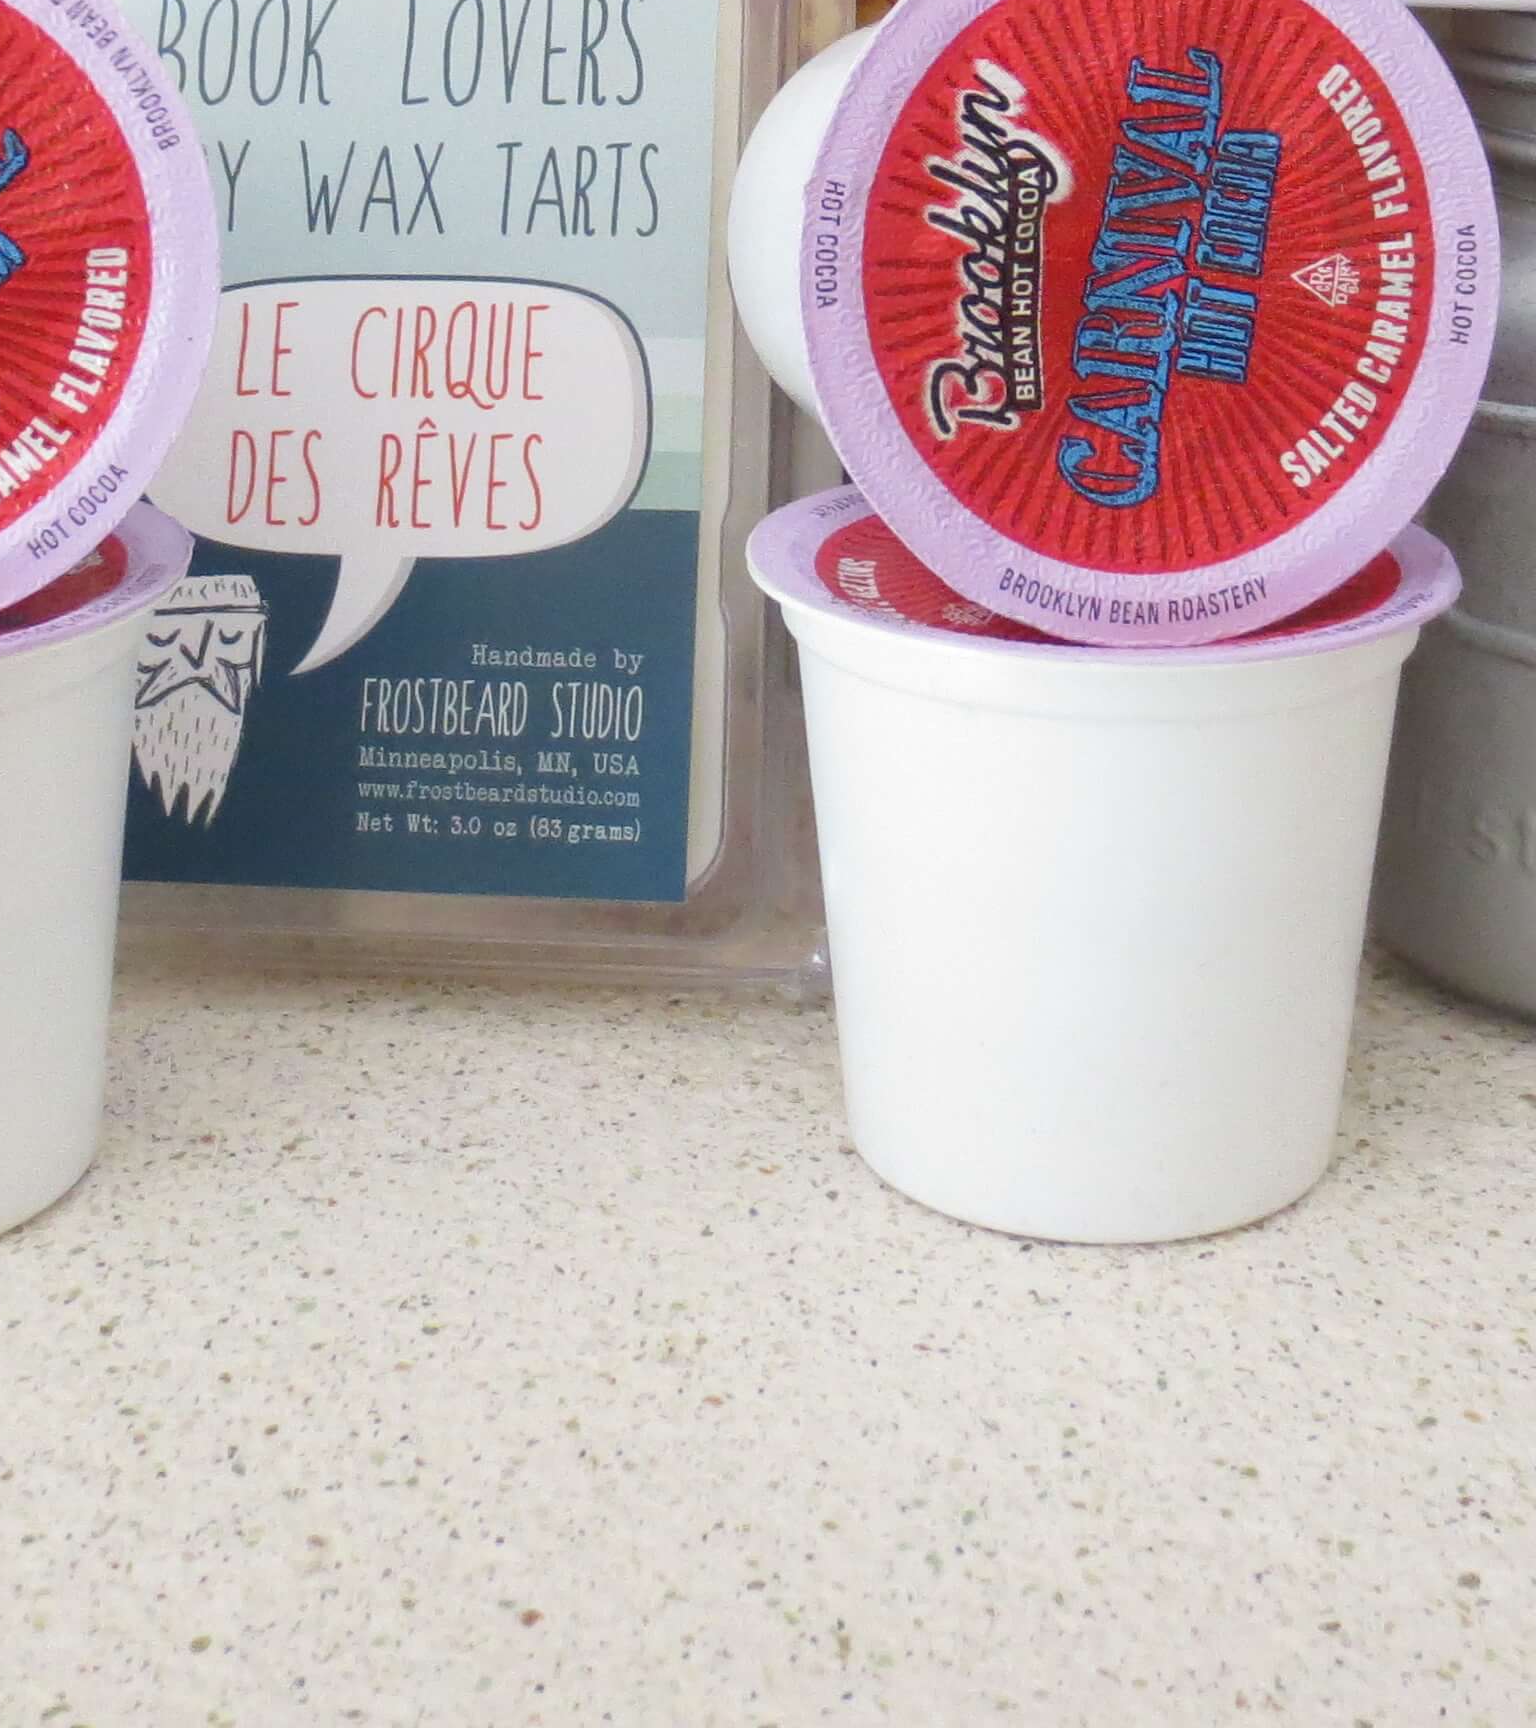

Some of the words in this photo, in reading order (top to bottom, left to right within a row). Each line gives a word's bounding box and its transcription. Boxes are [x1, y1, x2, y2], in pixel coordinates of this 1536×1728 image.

[300, 139, 446, 236] WAX
[496, 141, 660, 238] TARTS
[1315, 62, 1410, 223] FLAVORED
[819, 179, 847, 228] HOT
[921, 57, 1076, 441] Brooklyn
[1014, 164, 1041, 257] COCOA
[1194, 128, 1283, 277] COCOA
[814, 233, 839, 310] COCOA
[1010, 260, 1035, 319] HOT
[1056, 46, 1225, 509] CARNIVAL
[1457, 222, 1477, 297] COCOA
[49, 246, 129, 415] FLAVORED
[1175, 273, 1260, 385] HOT
[1355, 230, 1417, 386] CARAMEL
[1448, 300, 1477, 346] HOT
[235, 301, 300, 397] LE
[351, 300, 551, 410] CIRQUE
[1009, 328, 1037, 404] BEAN
[225, 428, 323, 527] DES
[375, 415, 545, 532] RÊVES
[1278, 378, 1378, 490] SALTED
[26, 519, 71, 560] HOT
[67, 463, 130, 526] COCOA
[998, 566, 1103, 622] BROOKLYN
[1108, 599, 1161, 626] BEAN
[1167, 575, 1268, 623] ROASTERY
[470, 643, 598, 670] Handmade
[613, 648, 645, 676] by
[360, 677, 529, 738] FROSTBEARD
[550, 681, 644, 743] STUDIO
[357, 744, 524, 778] Minneapolis,
[536, 750, 579, 779] MN,
[592, 752, 642, 777] USA
[357, 778, 642, 810] www.frostbeardstudio.com
[355, 811, 395, 834] Net
[406, 812, 440, 835] Wt:
[449, 814, 482, 837] 3.0
[492, 819, 519, 838] oz
